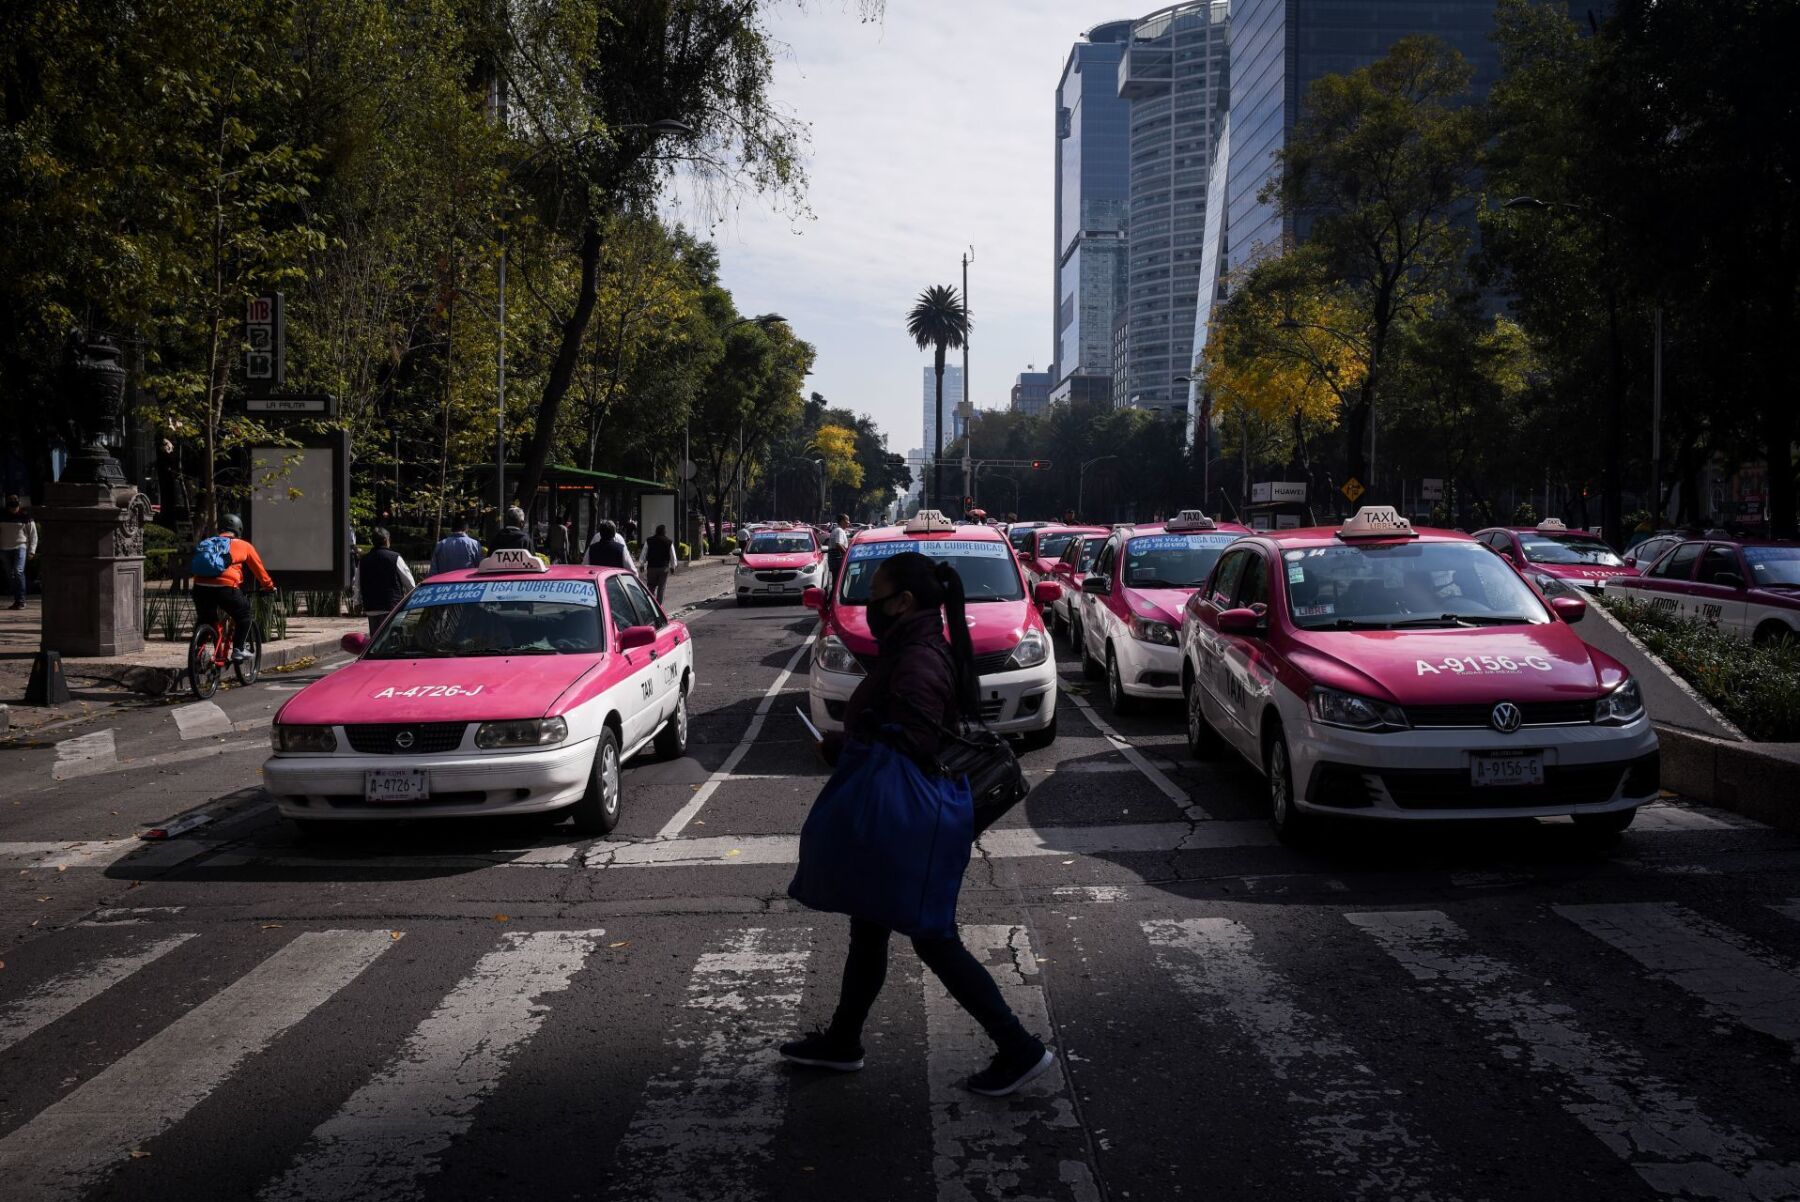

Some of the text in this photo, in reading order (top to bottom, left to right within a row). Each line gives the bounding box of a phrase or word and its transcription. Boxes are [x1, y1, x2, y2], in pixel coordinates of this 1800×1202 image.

[919, 513, 940, 521] TAXI
[1183, 512, 1200, 521] TAXI
[1364, 512, 1394, 523] TAXI
[923, 542, 1004, 552] USA CUBREBOCAS
[495, 551, 523, 563] TAXI
[455, 582, 486, 591] VIAJE
[490, 582, 595, 597] USA CUBREBOCAS
[435, 590, 481, 602] SEGURO
[1299, 606, 1328, 617] LIBRE
[1415, 655, 1553, 676] A-9156-G
[374, 684, 485, 699] A-4726-J
[640, 678, 654, 701] TAXI
[1225, 667, 1246, 711] TAXI
[1478, 759, 1537, 778] A-9156-G
[370, 777, 424, 794] A-4726-J
